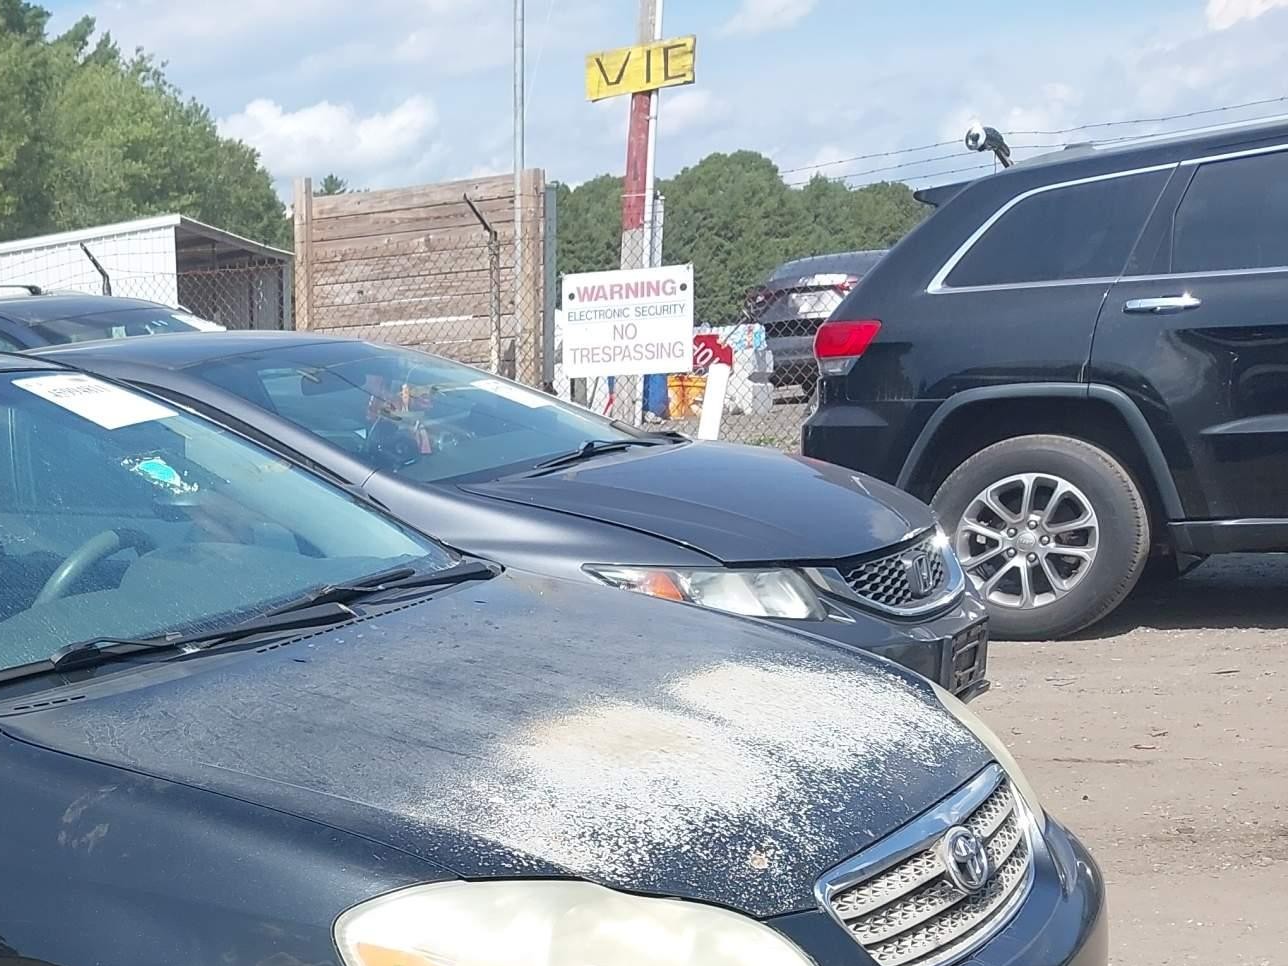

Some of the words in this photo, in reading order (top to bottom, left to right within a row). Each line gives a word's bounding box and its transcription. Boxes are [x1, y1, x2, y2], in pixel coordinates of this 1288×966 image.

[576, 279, 677, 303] WARNING
[567, 307, 630, 322] ELECTRONIC
[634, 303, 686, 318] SECURITY
[613, 322, 638, 341] NO
[569, 341, 685, 365] TRESPASSING
